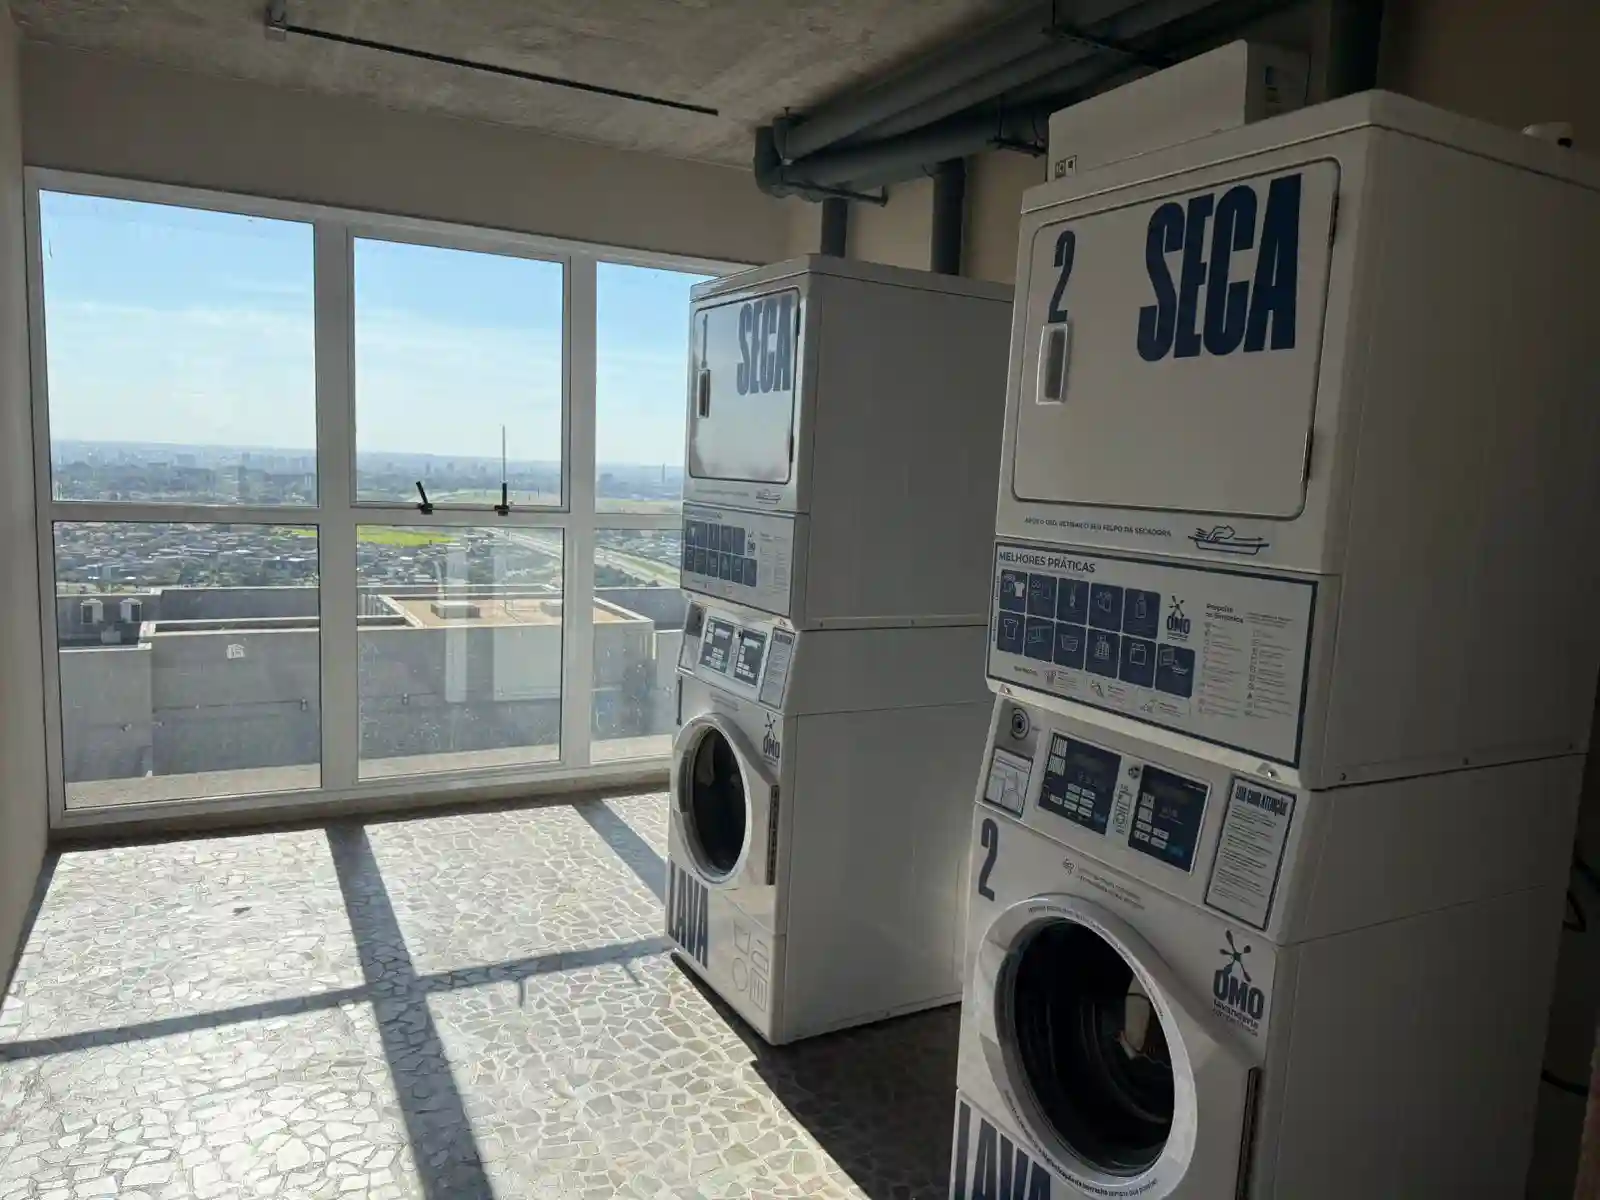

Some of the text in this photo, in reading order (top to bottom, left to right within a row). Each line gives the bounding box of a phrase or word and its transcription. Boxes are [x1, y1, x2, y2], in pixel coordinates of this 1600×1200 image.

[1048, 230, 1076, 323] 2
[1137, 173, 1302, 362] SECA
[737, 295, 792, 395] SECA
[999, 551, 1046, 567] MELHORES
[1047, 556, 1096, 573] PRÁTICAS
[1167, 615, 1191, 634] OMO
[763, 736, 780, 758] OMO
[978, 817, 999, 902] 2
[668, 859, 708, 970] LAVA
[1213, 969, 1265, 1020] OMO
[954, 1101, 1051, 1200] LA
